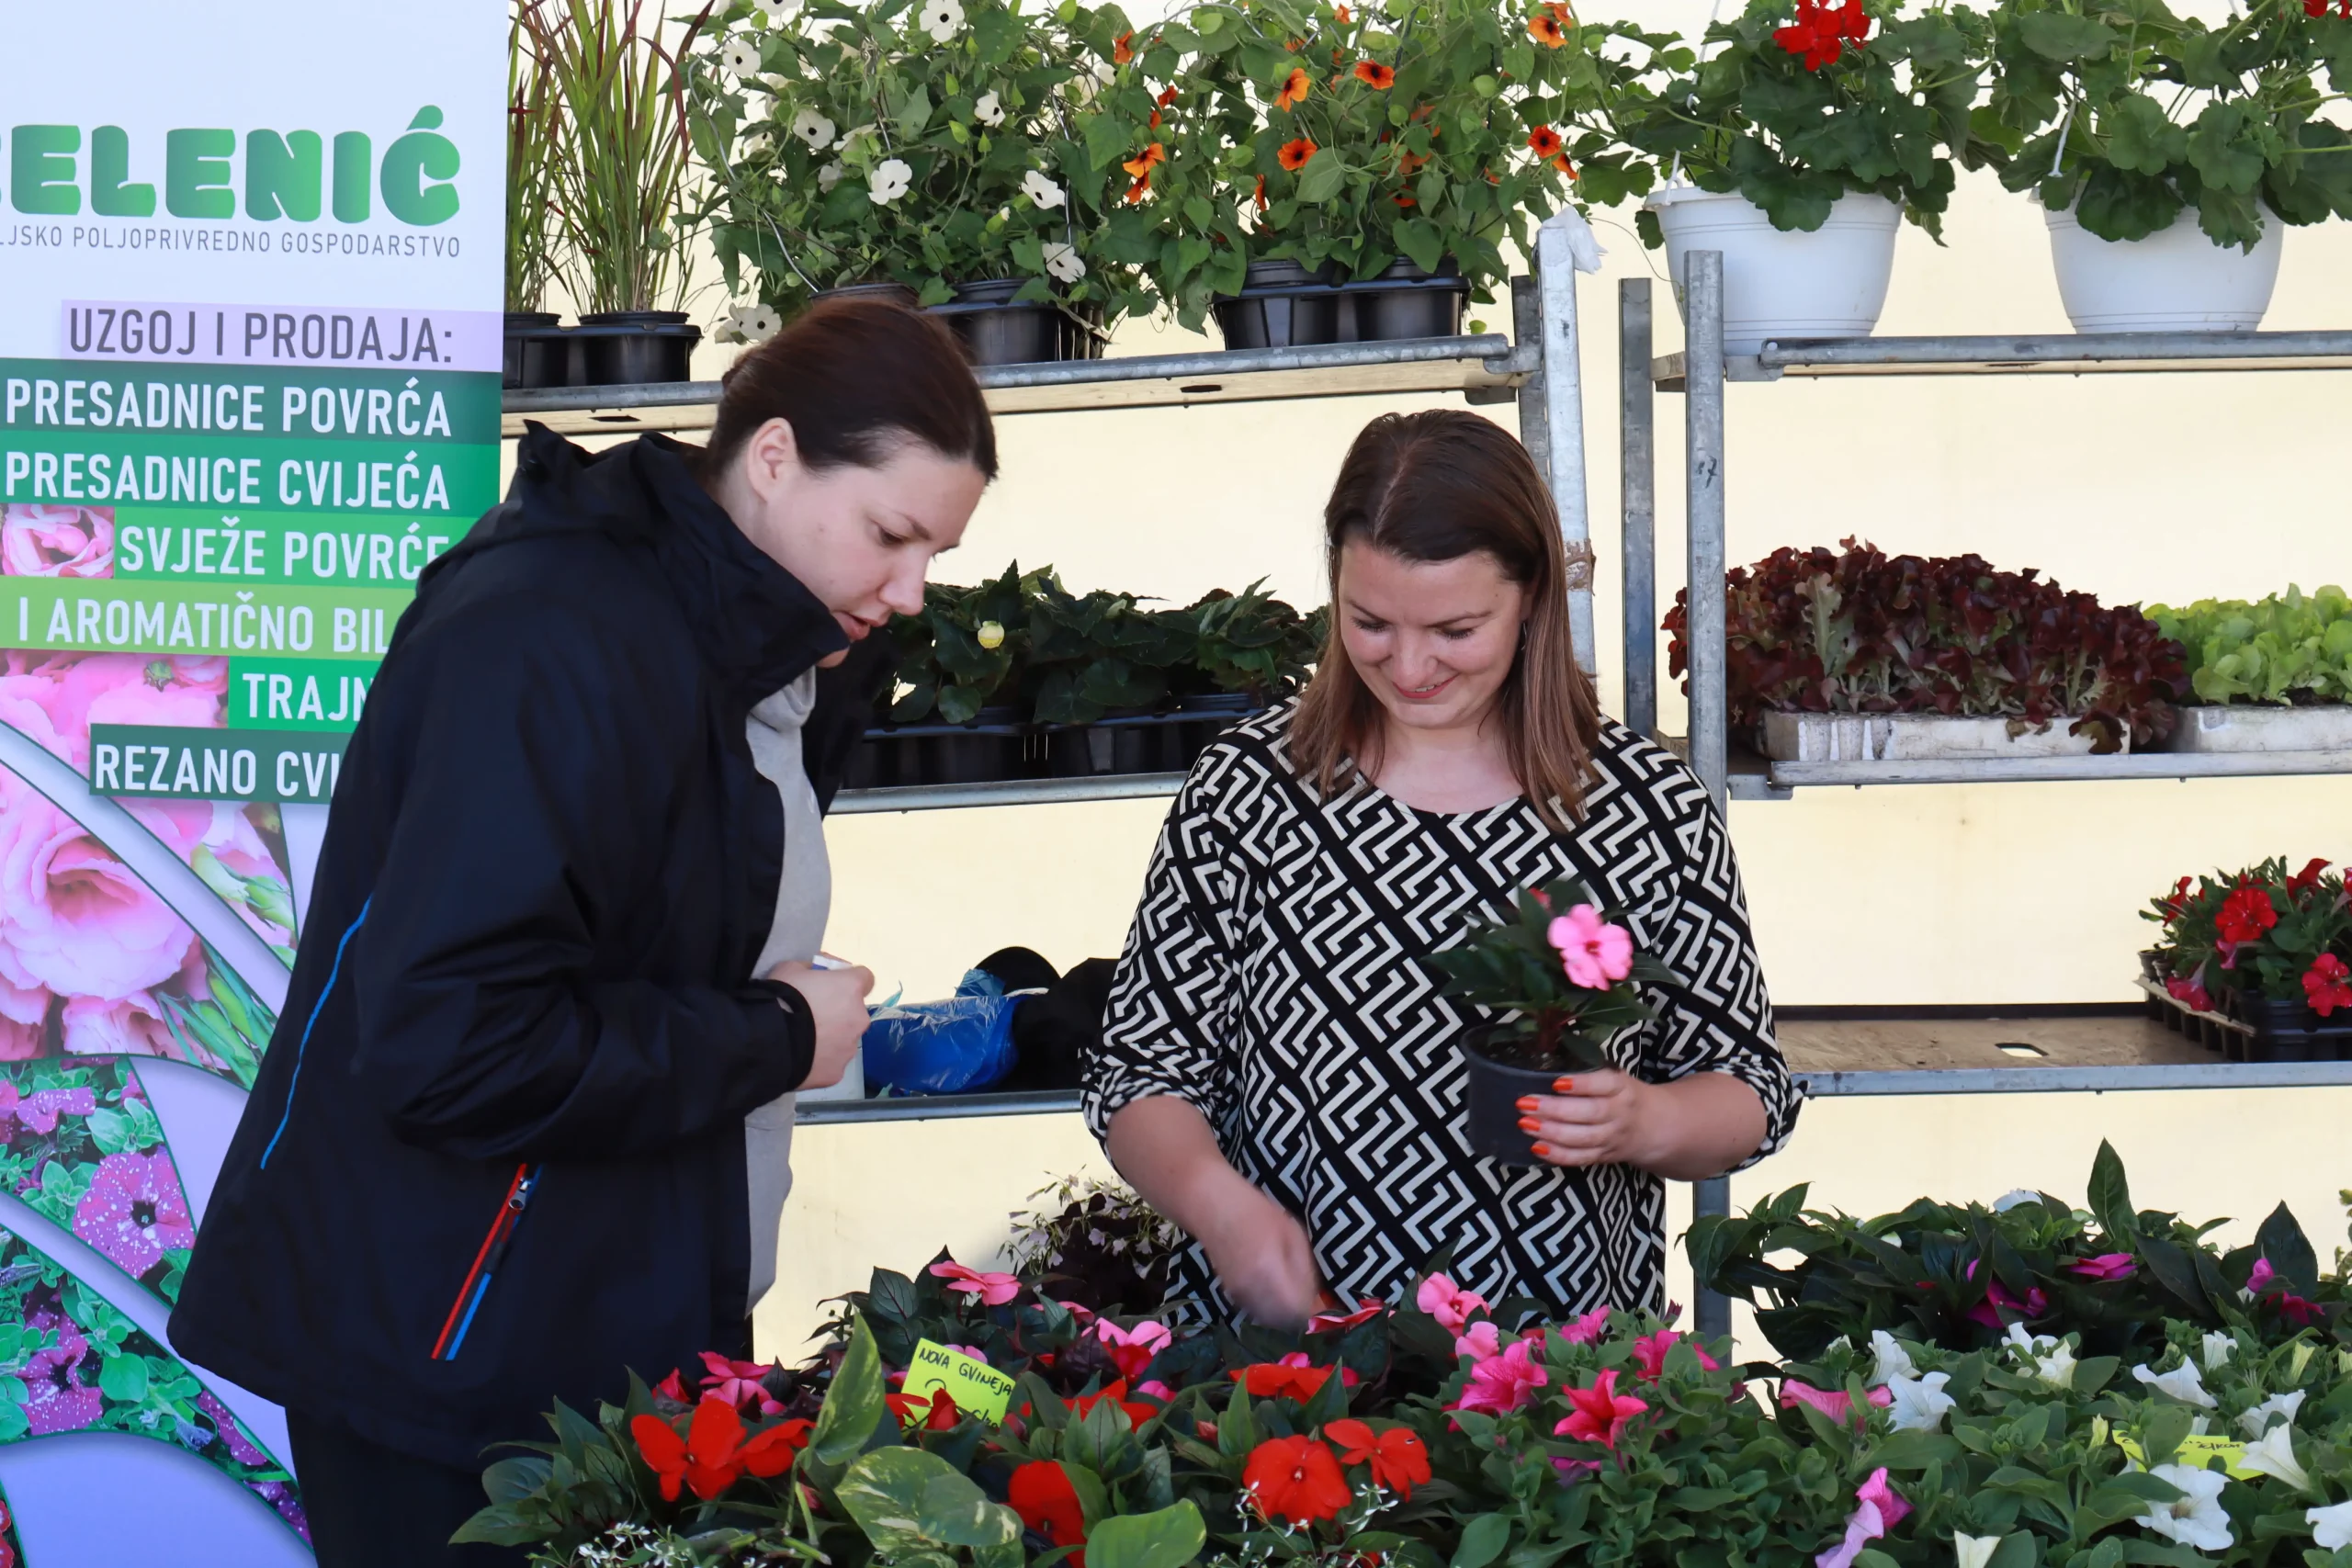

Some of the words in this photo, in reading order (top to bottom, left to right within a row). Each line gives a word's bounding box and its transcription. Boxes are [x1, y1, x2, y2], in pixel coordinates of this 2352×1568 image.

[0, 105, 460, 227] ELENIĆ
[0, 224, 62, 246] JSKO
[74, 228, 271, 254] POLJOPRIVREDNO
[281, 231, 460, 258] GOSPODARSTVO
[70, 308, 196, 355] UZGOJ
[216, 311, 223, 356] I
[244, 313, 453, 363] PRODAJA:
[6, 378, 265, 432] PRESADNICE
[283, 377, 452, 437] POVRĆA
[6, 451, 262, 504] PRESADNICE
[278, 450, 450, 510] CVIJEĆA
[120, 516, 266, 576] SVJEŽE
[18, 596, 28, 641] I
[47, 591, 313, 653] AROMATIČNO
[96, 744, 256, 795] REZANO
[918, 1348, 950, 1369] NOVA
[958, 1362, 1012, 1396] GVINEJA
